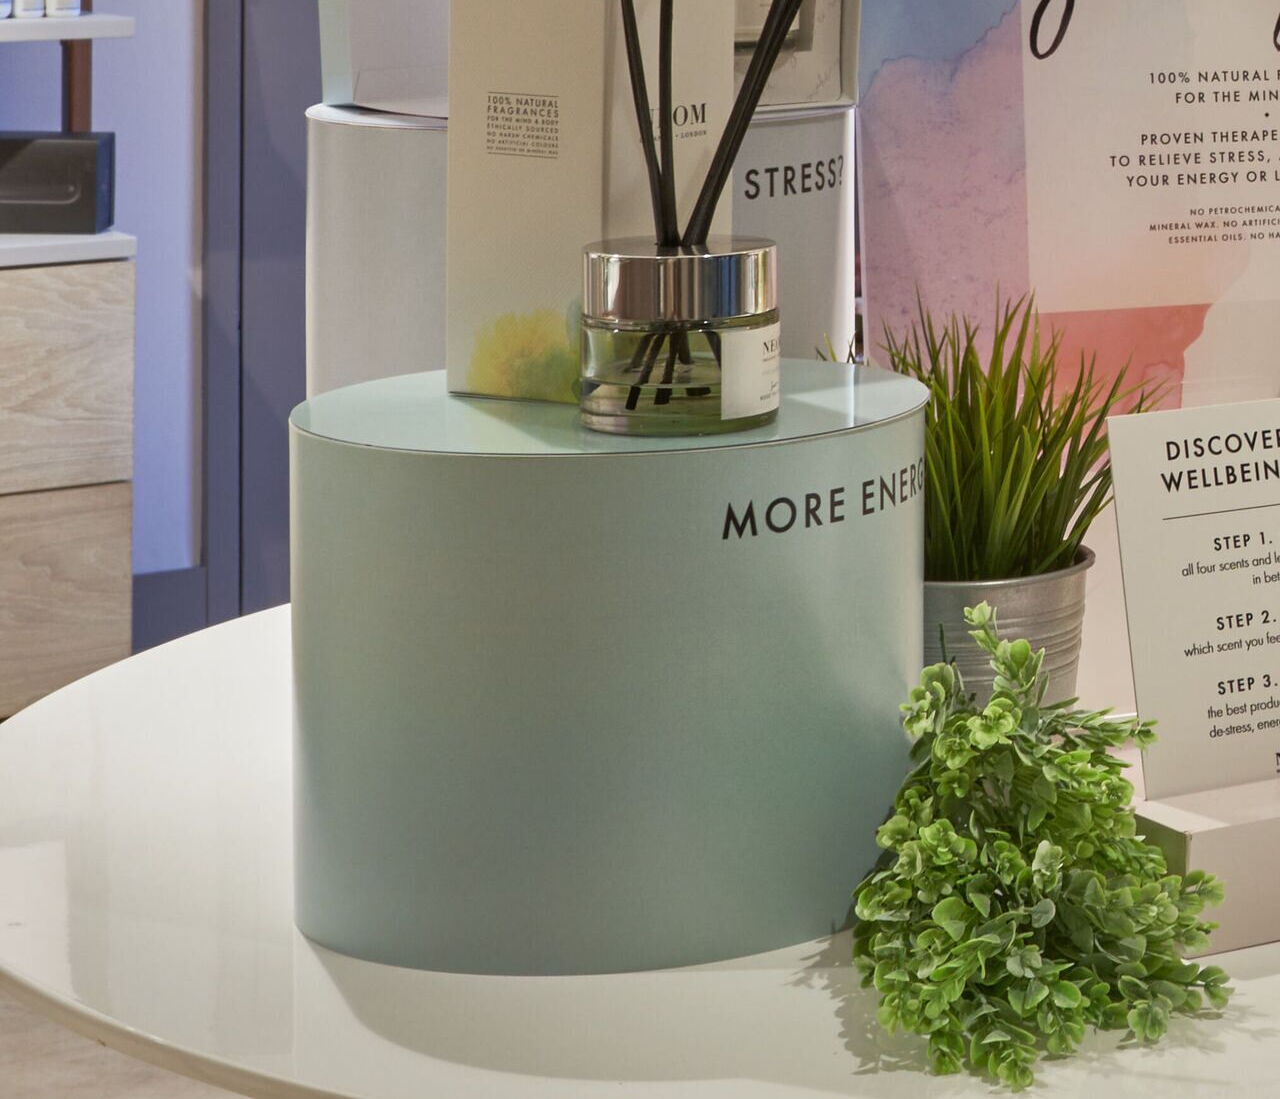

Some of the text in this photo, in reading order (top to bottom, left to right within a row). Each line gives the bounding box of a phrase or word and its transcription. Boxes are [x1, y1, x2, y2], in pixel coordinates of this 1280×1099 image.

[1150, 72, 1190, 84] 100%
[1198, 69, 1270, 82] NATURAL
[488, 96, 559, 108] 100% NATURAL
[1175, 91, 1206, 104] FOR
[1213, 90, 1241, 103] THE
[487, 105, 559, 118] FRAGRANCES
[1140, 132, 1204, 145] PROVEN
[1110, 154, 1130, 167] TO
[1139, 152, 1201, 166] RELIEVE
[1209, 150, 1271, 165] STRESS,
[744, 154, 844, 200] STRESS?
[1126, 174, 1170, 188] YOUR
[1177, 171, 1239, 186] ENERGY
[1246, 170, 1267, 183] OR
[722, 457, 924, 540] MORE ENERG
[1214, 533, 1251, 552] STEP
[1259, 531, 1274, 545] 1.
[1181, 562, 1194, 578] all
[1196, 561, 1216, 575] four
[1219, 557, 1250, 573] scents
[1252, 553, 1271, 568] and
[1252, 574, 1262, 585] in
[1216, 612, 1254, 631] STEP
[1261, 609, 1277, 625] 2.
[1183, 641, 1214, 658] which
[1216, 638, 1243, 653] scent
[1245, 636, 1264, 651] you
[1217, 676, 1255, 695] STEP
[1262, 673, 1279, 689] 3.
[1207, 704, 1223, 719] the
[1225, 702, 1247, 716] best
[1209, 719, 1255, 739] de-stress,
